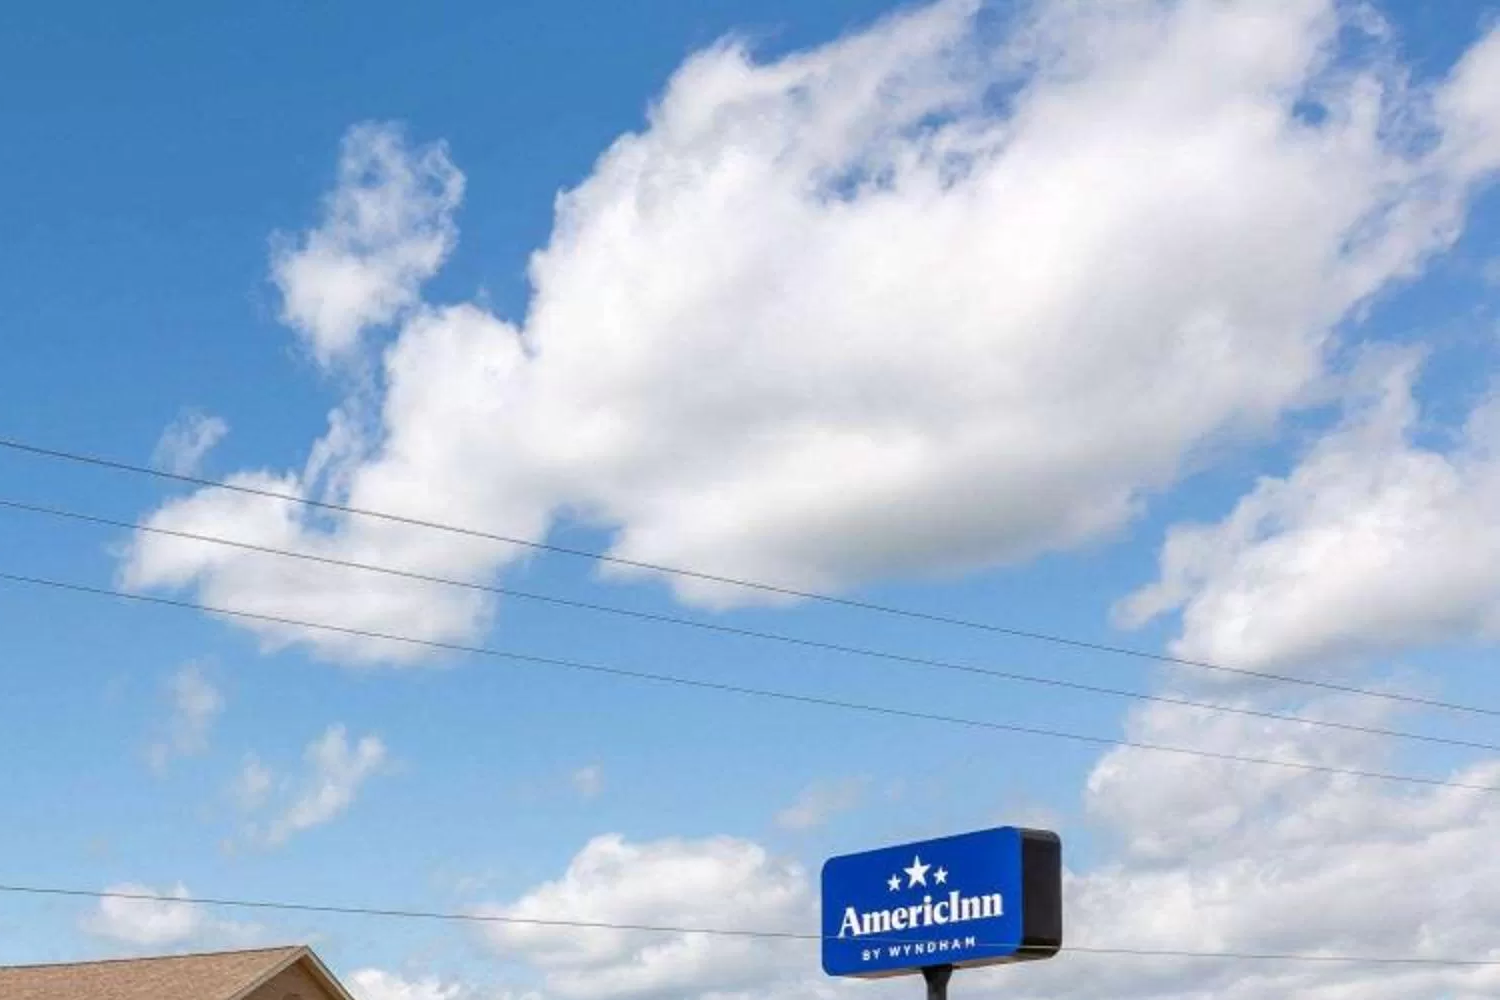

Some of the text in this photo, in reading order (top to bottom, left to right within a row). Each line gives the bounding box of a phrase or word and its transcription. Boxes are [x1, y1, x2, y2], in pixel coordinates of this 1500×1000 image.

[838, 890, 1003, 938] AmericInn
[862, 936, 976, 961] BY WYNDHAM
